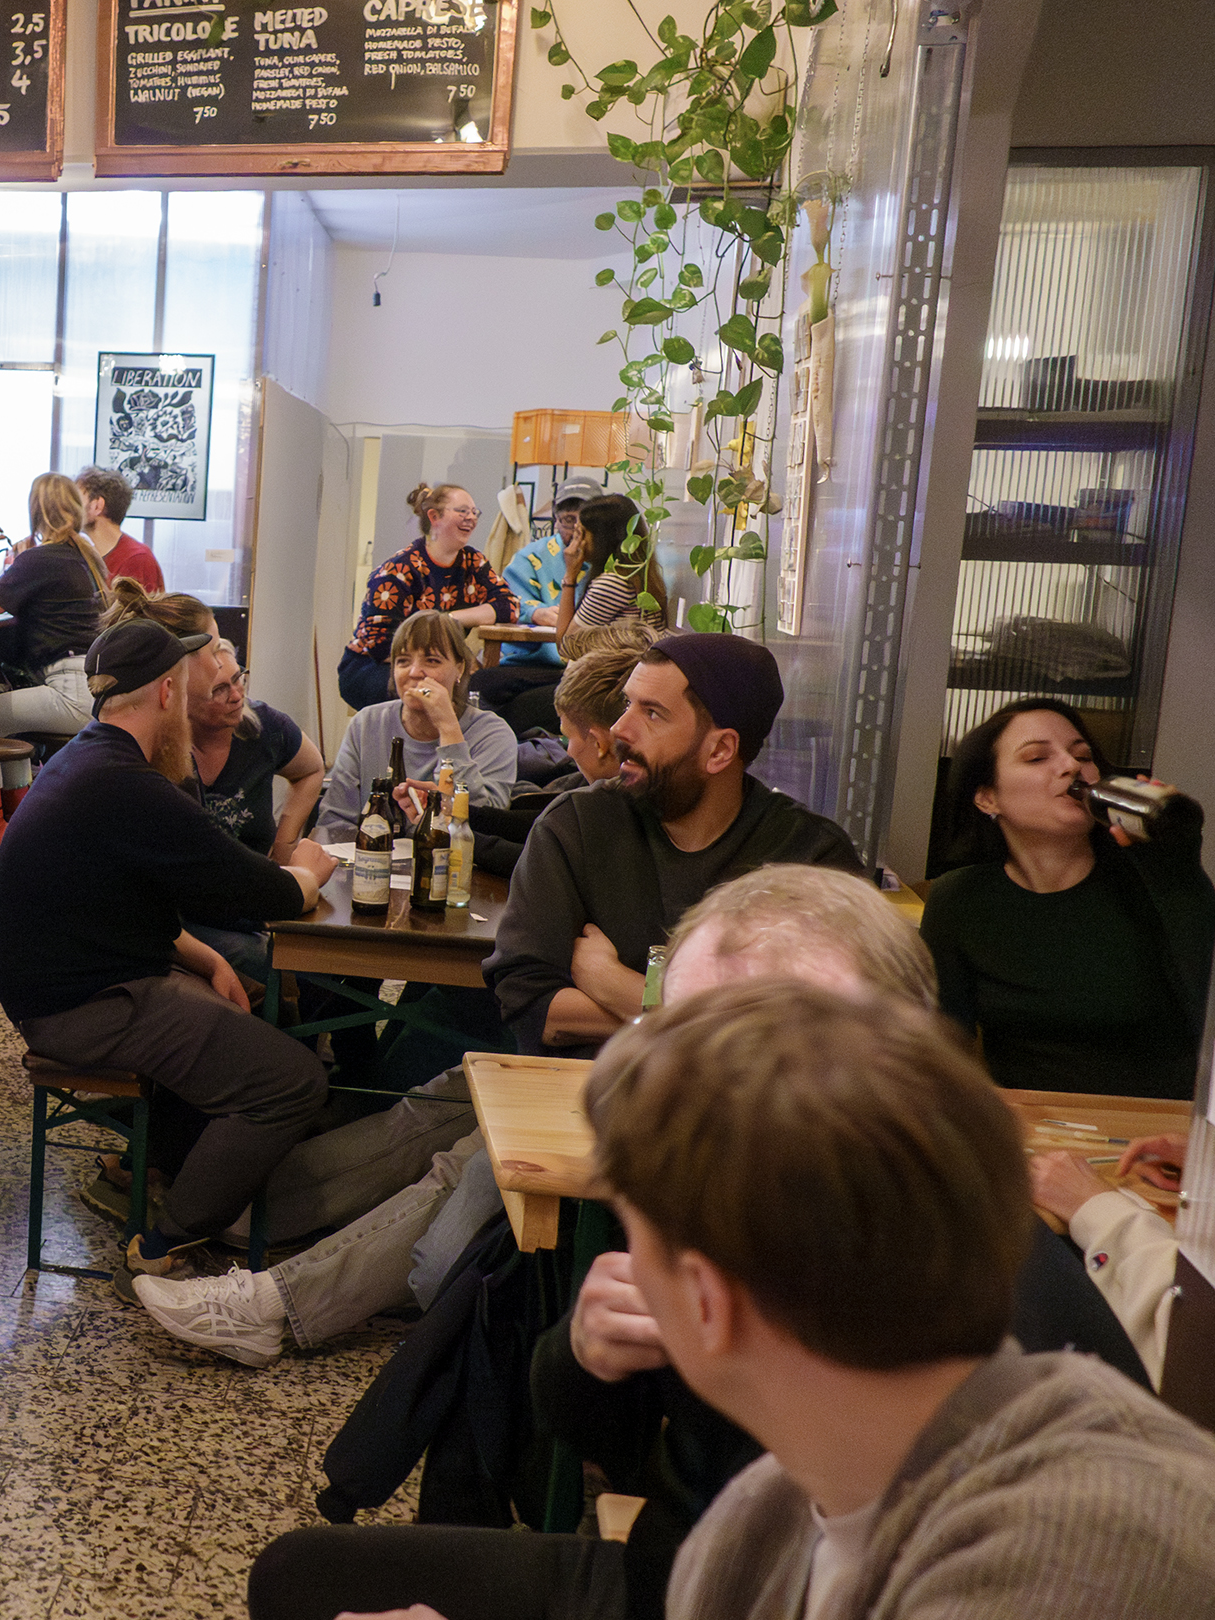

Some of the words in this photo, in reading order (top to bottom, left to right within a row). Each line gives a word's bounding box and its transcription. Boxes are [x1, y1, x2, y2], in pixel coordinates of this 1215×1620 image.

[363, 0, 484, 22] CAPRESE
[11, 13, 45, 35] 2,5
[254, 7, 328, 32] MELTED
[125, 16, 239, 44] TRICOLOE
[427, 25, 438, 34] DI
[439, 24, 481, 36] BUFAL,
[254, 29, 318, 51] TUNA
[427, 37, 465, 49] PESTO,
[11, 40, 47, 66] 3,5
[127, 51, 173, 65] GRILLED
[364, 50, 397, 61] FRESH
[401, 49, 467, 62] TOMATOES,
[176, 60, 221, 73] SUNDRIED
[254, 56, 282, 67] TUNA,
[293, 66, 311, 76] RED
[364, 63, 386, 75] RED
[425, 62, 480, 76] BALSAMICO
[11, 69, 31, 95] 4
[253, 80, 279, 89] FRESH
[130, 88, 181, 103] WALNUT
[187, 83, 225, 100] (VEGAN)
[306, 88, 316, 97] DI
[252, 99, 303, 110] HOMEMADE
[305, 99, 338, 109] PESTO
[112, 369, 200, 387] LIBERATION
